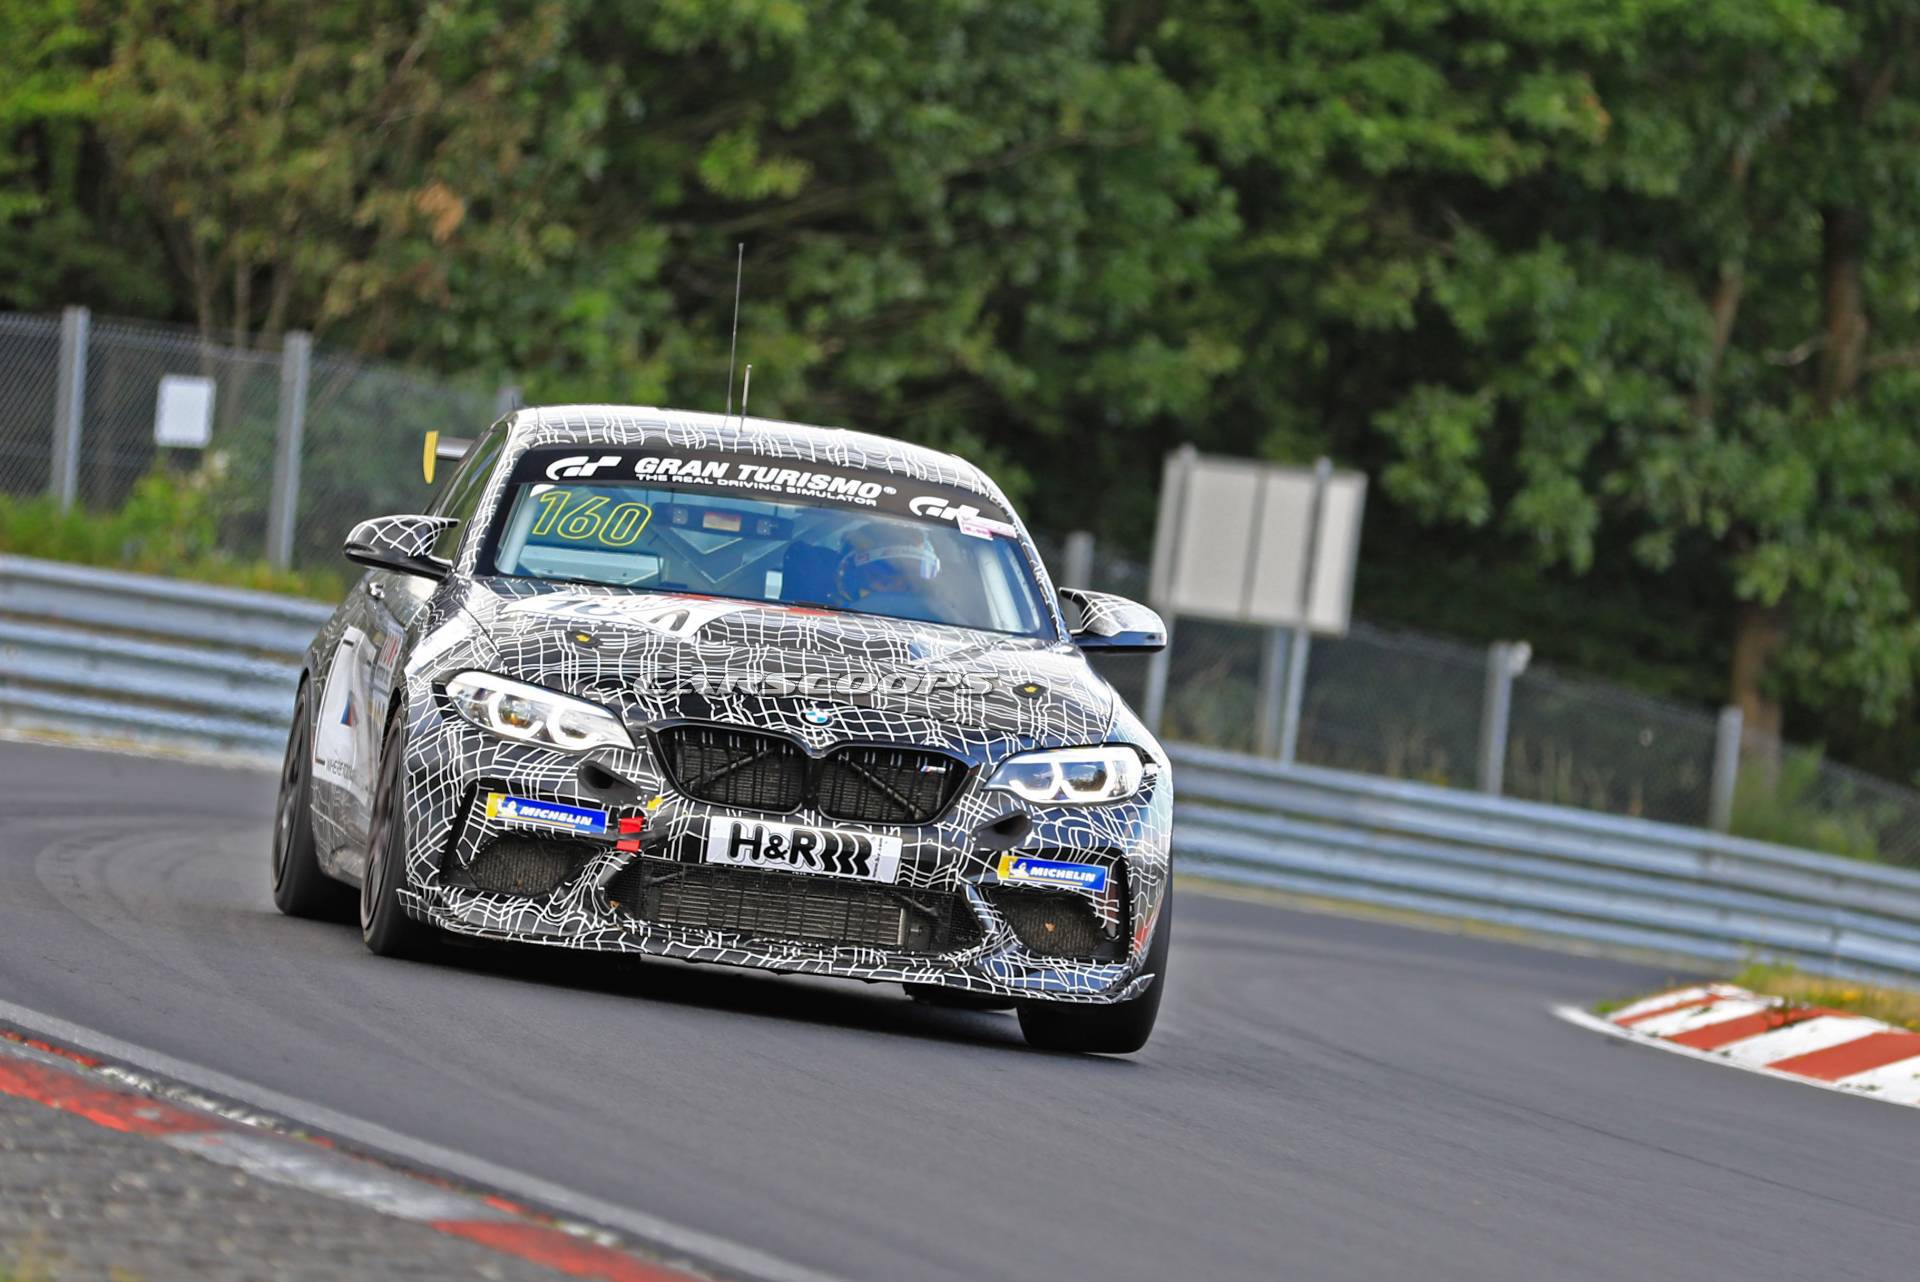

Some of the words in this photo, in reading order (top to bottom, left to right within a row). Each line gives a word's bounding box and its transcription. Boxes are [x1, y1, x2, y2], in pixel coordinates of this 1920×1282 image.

[634, 457, 730, 479] GRAN
[636, 473, 668, 482] THE
[672, 475, 714, 485] REAL
[717, 479, 782, 492] DRIVING
[786, 486, 877, 507] SIMULATOR
[532, 490, 653, 547] 160
[519, 806, 593, 826] MICHELIN
[728, 820, 825, 872] H&R
[1030, 866, 1096, 883] MICHELIN
